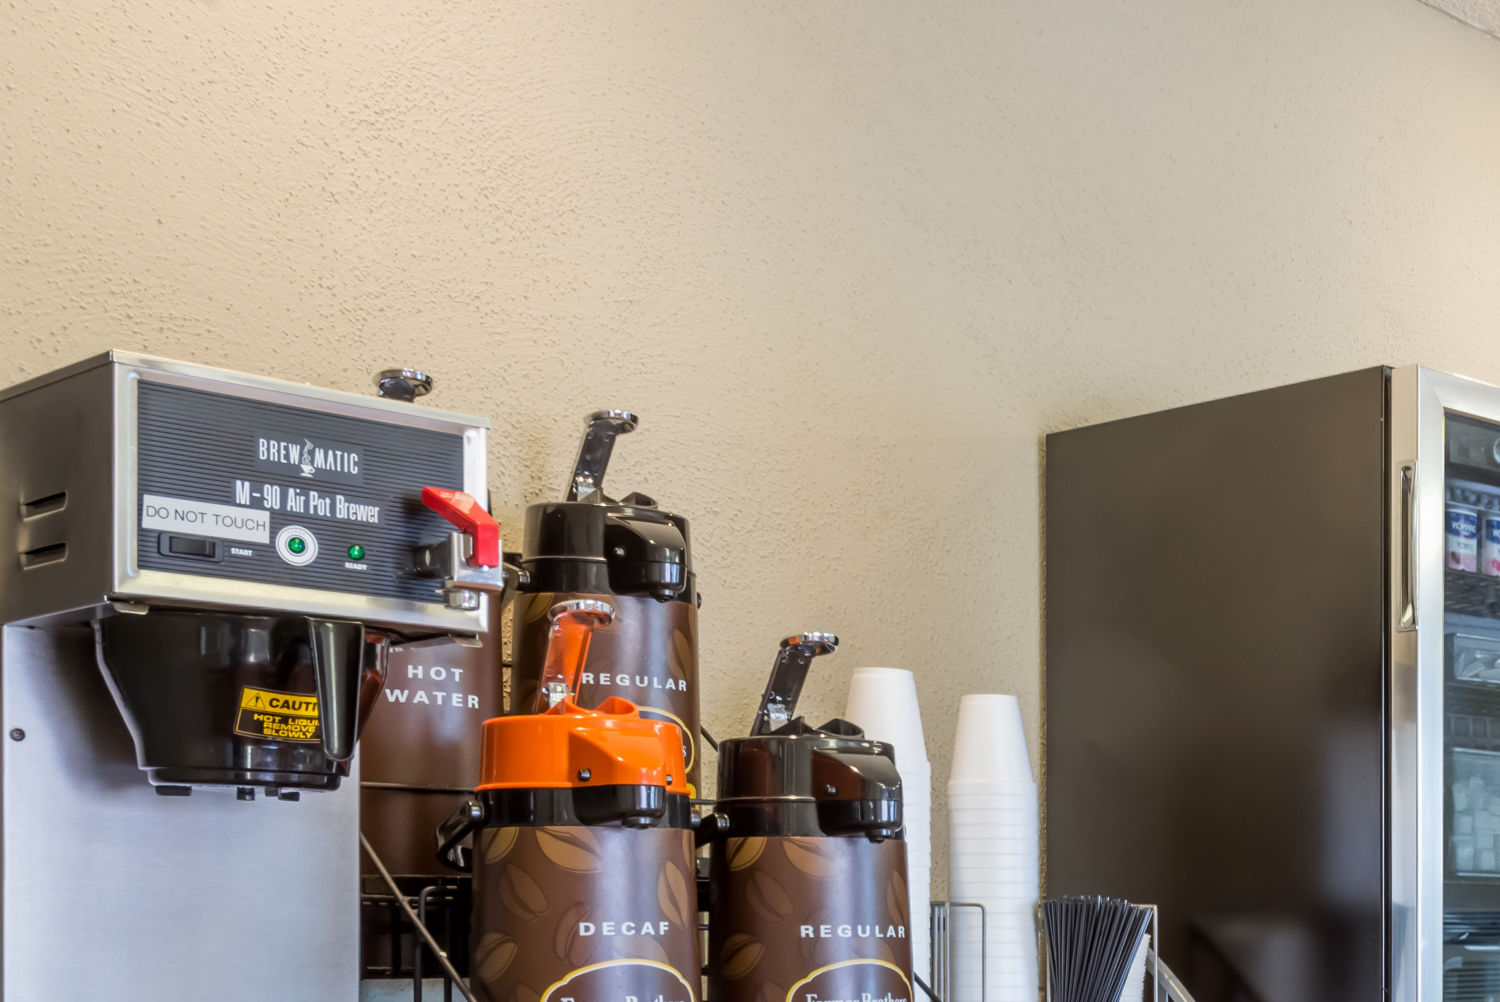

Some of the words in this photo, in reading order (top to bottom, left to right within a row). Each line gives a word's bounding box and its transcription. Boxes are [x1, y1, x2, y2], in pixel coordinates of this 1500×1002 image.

[287, 488, 306, 513] Air
[309, 490, 331, 516] Pot
[336, 495, 380, 523] Brewer
[146, 505, 169, 519] DO
[174, 509, 208, 524] NOT
[212, 513, 266, 532] TOUCH
[230, 547, 253, 556] START
[345, 562, 367, 570] READY
[407, 665, 463, 682] HOT
[582, 672, 687, 691] REGULAR
[269, 698, 318, 712] CAUTI
[385, 689, 479, 709] WATER
[254, 714, 281, 722] HOT
[289, 718, 319, 726] LIQUI
[264, 723, 315, 732] REMOVE
[264, 729, 313, 738] SLOWLY
[578, 921, 672, 937] DECAF
[800, 924, 906, 939] REGULAR
